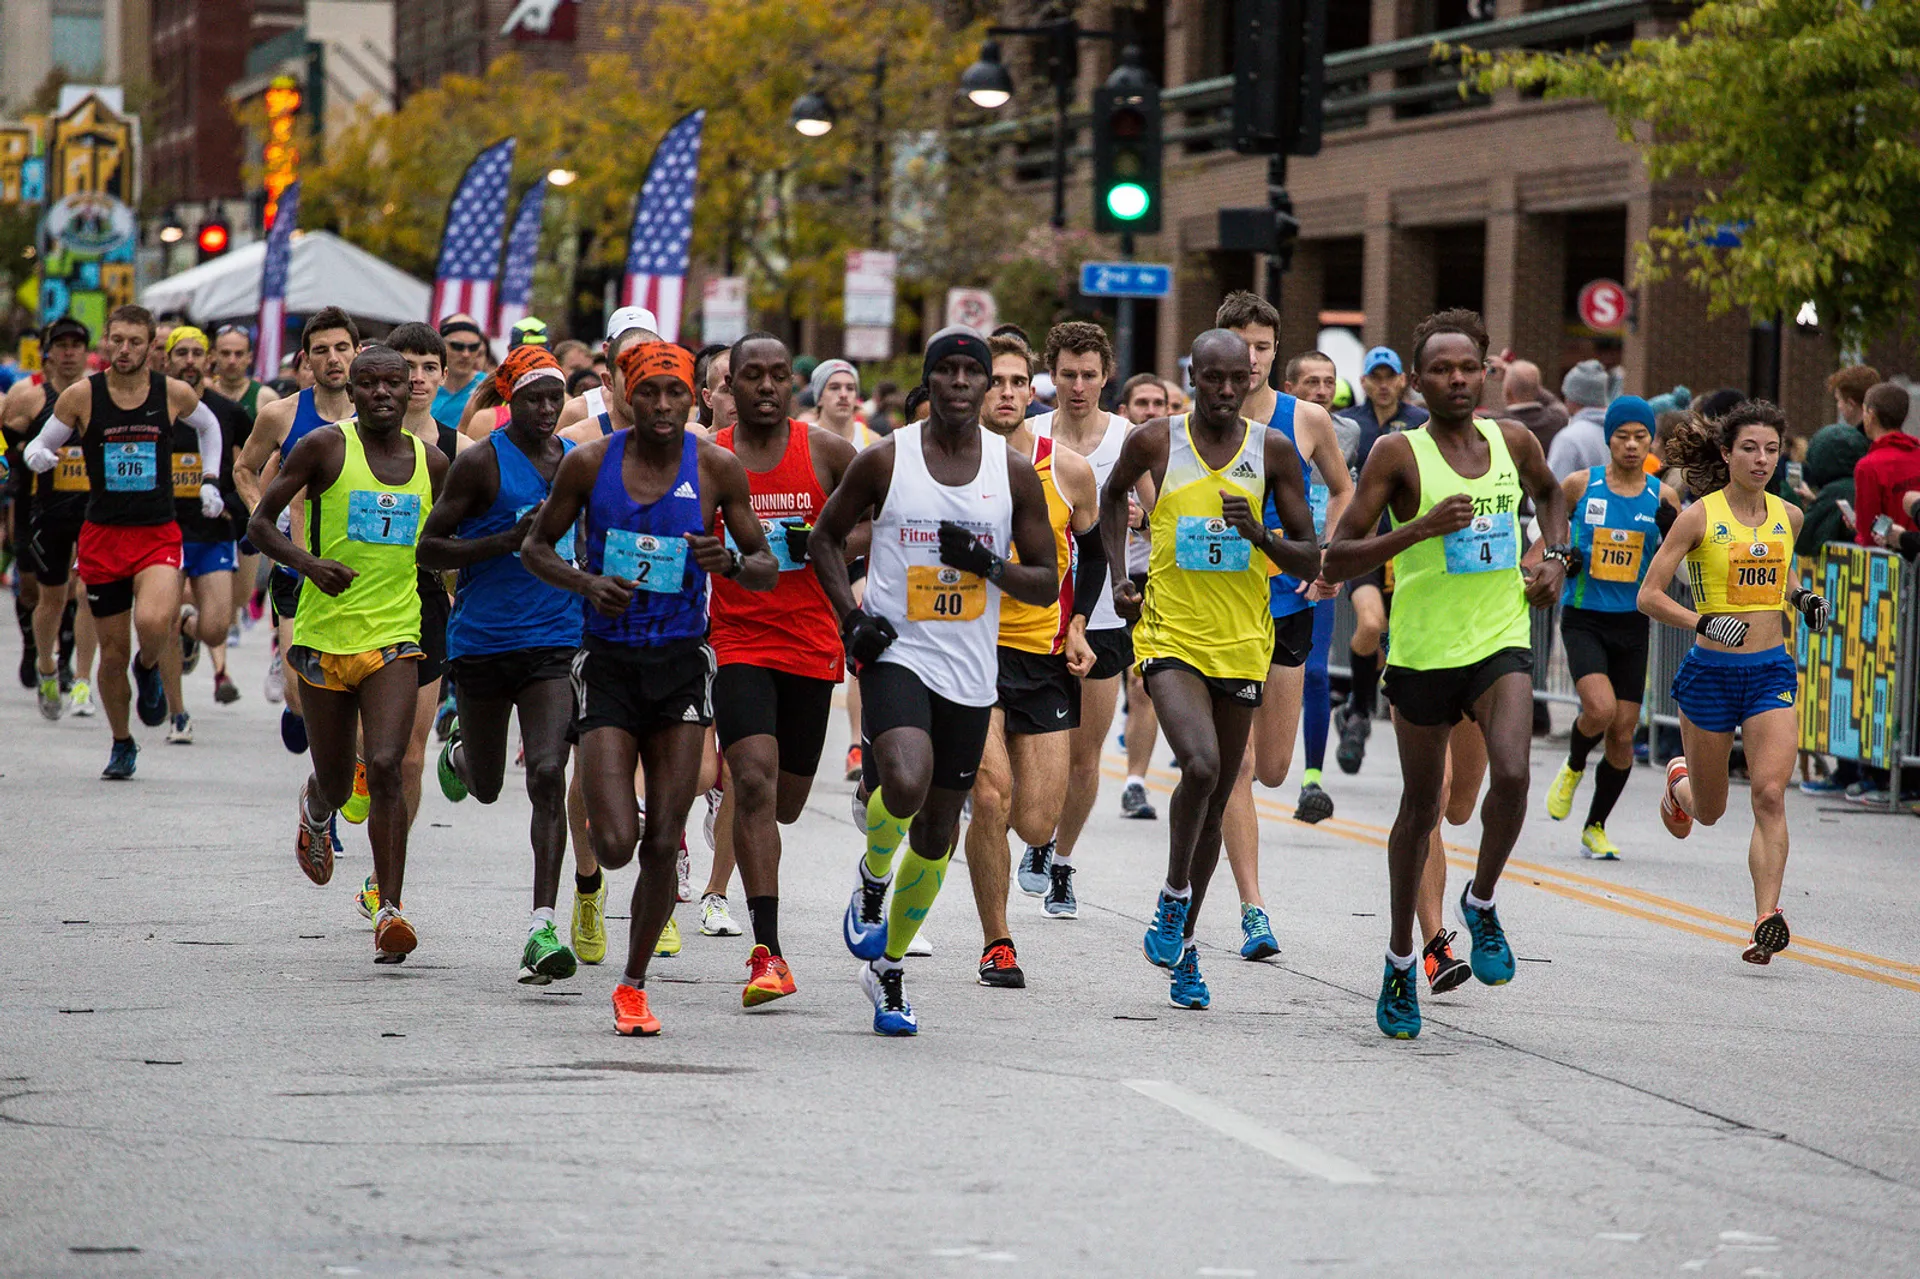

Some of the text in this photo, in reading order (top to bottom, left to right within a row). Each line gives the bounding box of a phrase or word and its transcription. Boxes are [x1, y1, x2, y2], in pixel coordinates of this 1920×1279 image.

[1593, 287, 1617, 322] S
[117, 462, 144, 477] 876
[1231, 470, 1257, 479] adidas
[749, 492, 813, 510] RUNNING CO.
[381, 517, 391, 538] 7
[1208, 543, 1222, 565] 5
[1480, 542, 1492, 564] 4
[1601, 548, 1632, 567] 7167
[637, 560, 651, 583] 2
[1738, 567, 1777, 586] 7084
[933, 593, 962, 615] 40
